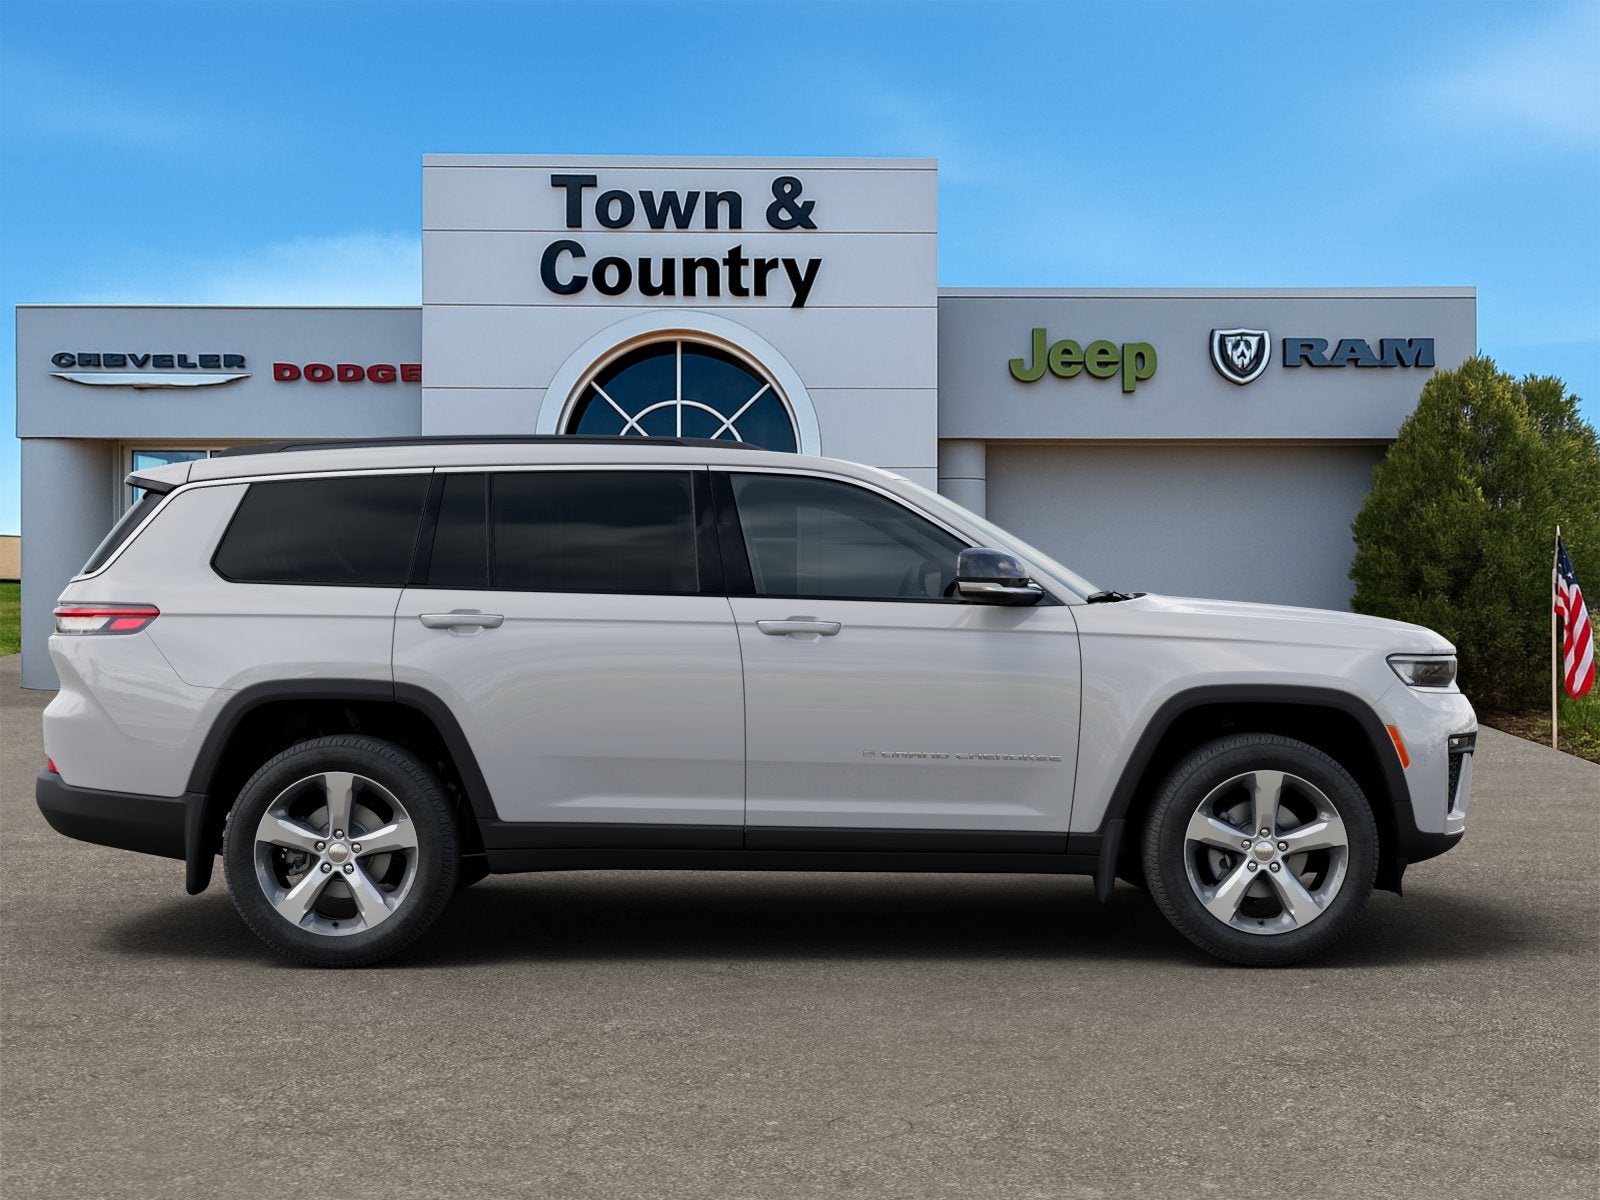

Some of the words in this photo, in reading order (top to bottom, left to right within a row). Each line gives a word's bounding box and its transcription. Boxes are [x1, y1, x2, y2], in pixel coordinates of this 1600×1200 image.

[550, 174, 743, 229] Town
[765, 175, 819, 230] &
[540, 239, 822, 308] Country
[273, 363, 422, 383] DODGE
[1009, 328, 1157, 392] Jeep
[1283, 338, 1435, 368] RAM
[881, 751, 949, 759] GRAND
[955, 752, 1062, 762] CHEROKEE
